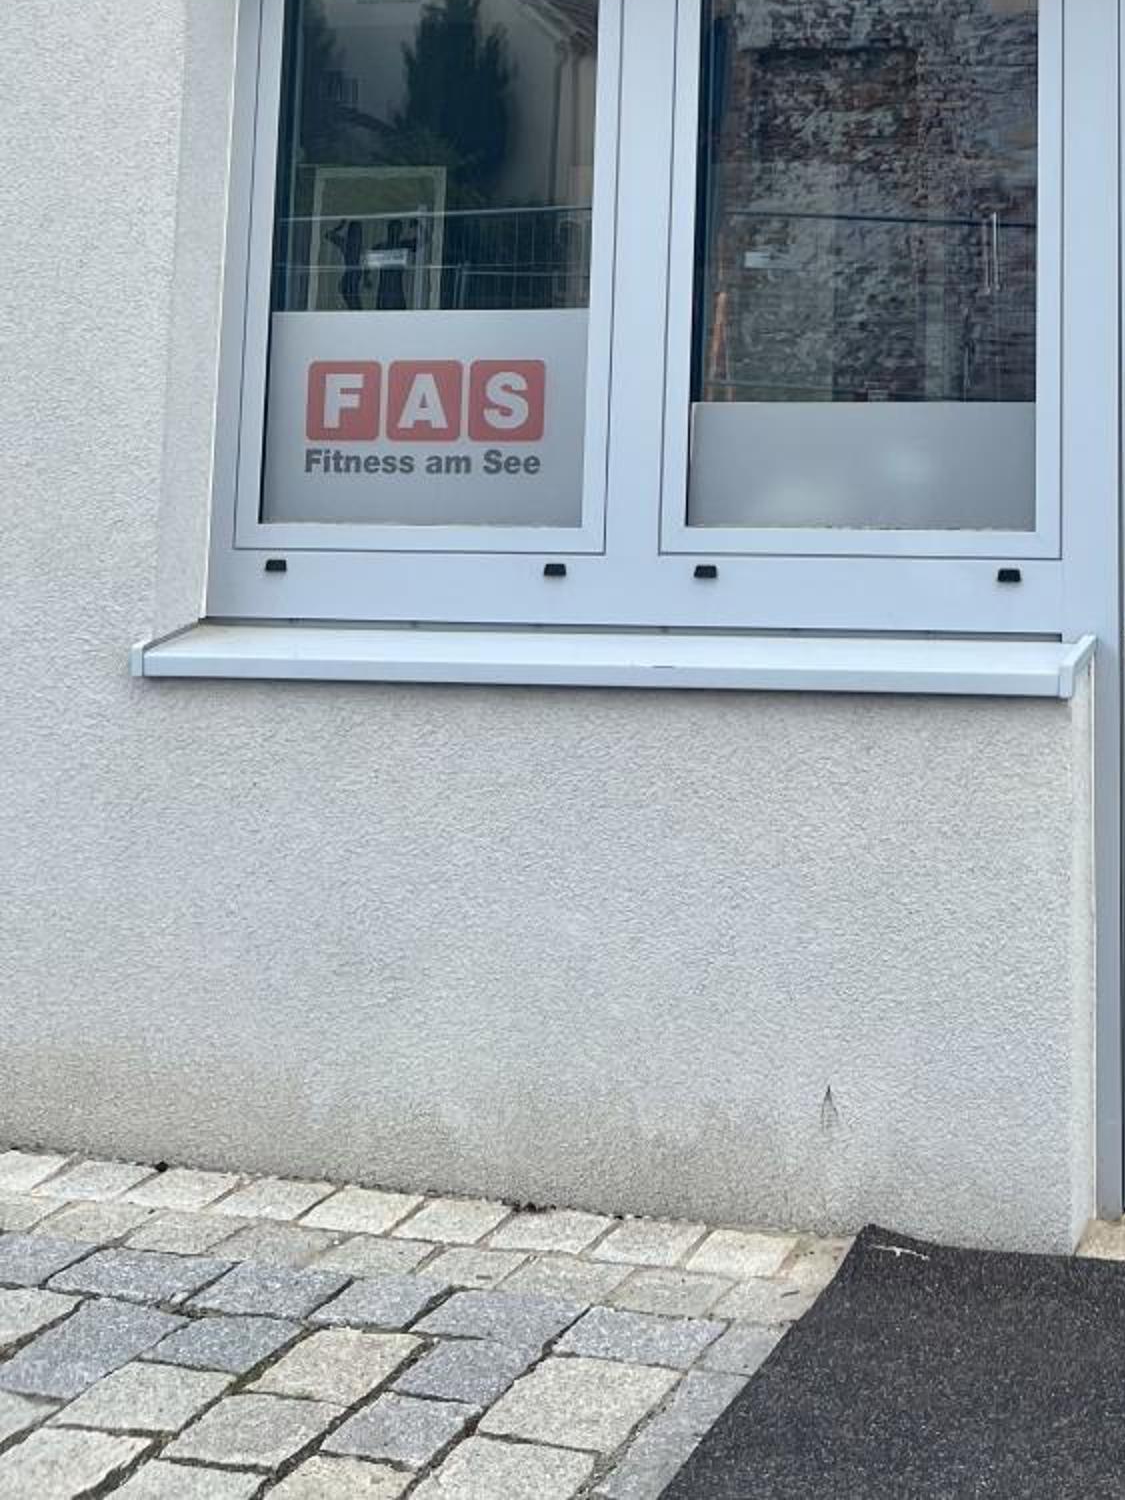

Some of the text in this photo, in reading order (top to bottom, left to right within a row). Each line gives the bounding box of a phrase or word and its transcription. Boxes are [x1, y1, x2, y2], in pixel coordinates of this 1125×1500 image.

[323, 372, 530, 430] FAS
[304, 449, 541, 475] Fitness am See
